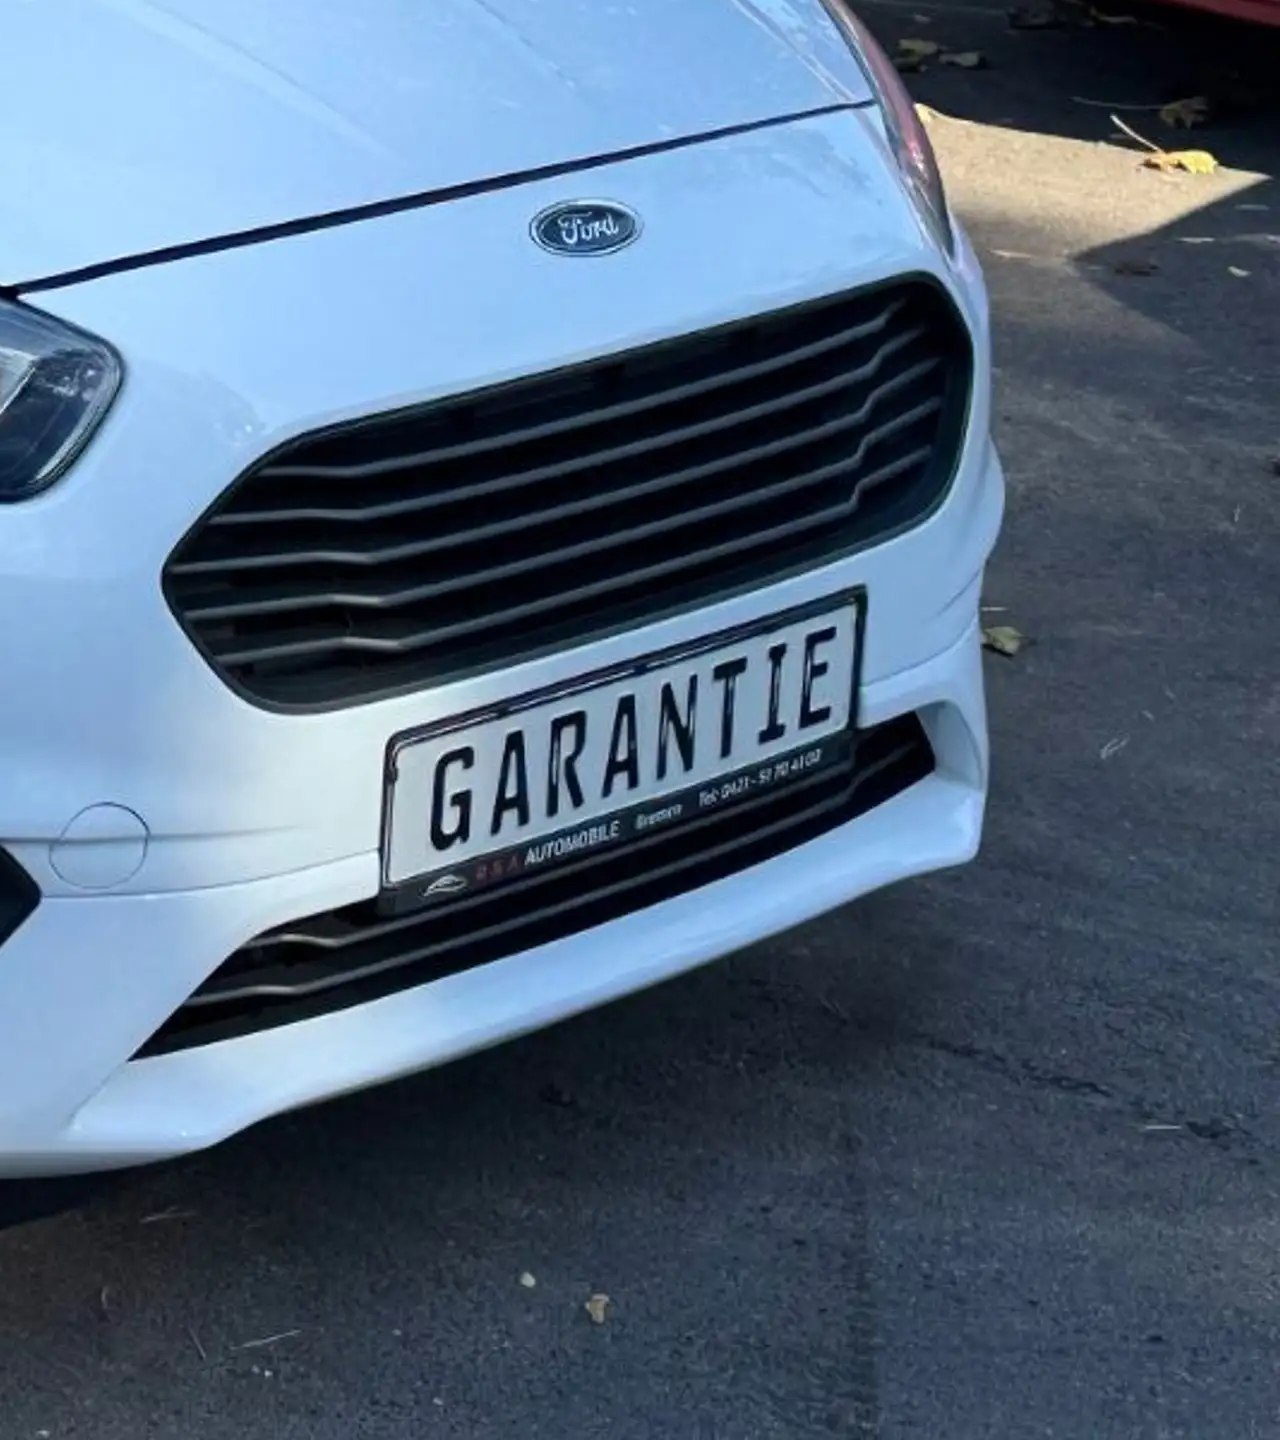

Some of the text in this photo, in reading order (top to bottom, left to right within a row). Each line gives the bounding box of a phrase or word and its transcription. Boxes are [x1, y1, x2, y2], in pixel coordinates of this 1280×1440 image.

[557, 210, 619, 244] Ford
[428, 625, 838, 852] GARANTIE
[524, 819, 621, 867] AUTOMOBILE
